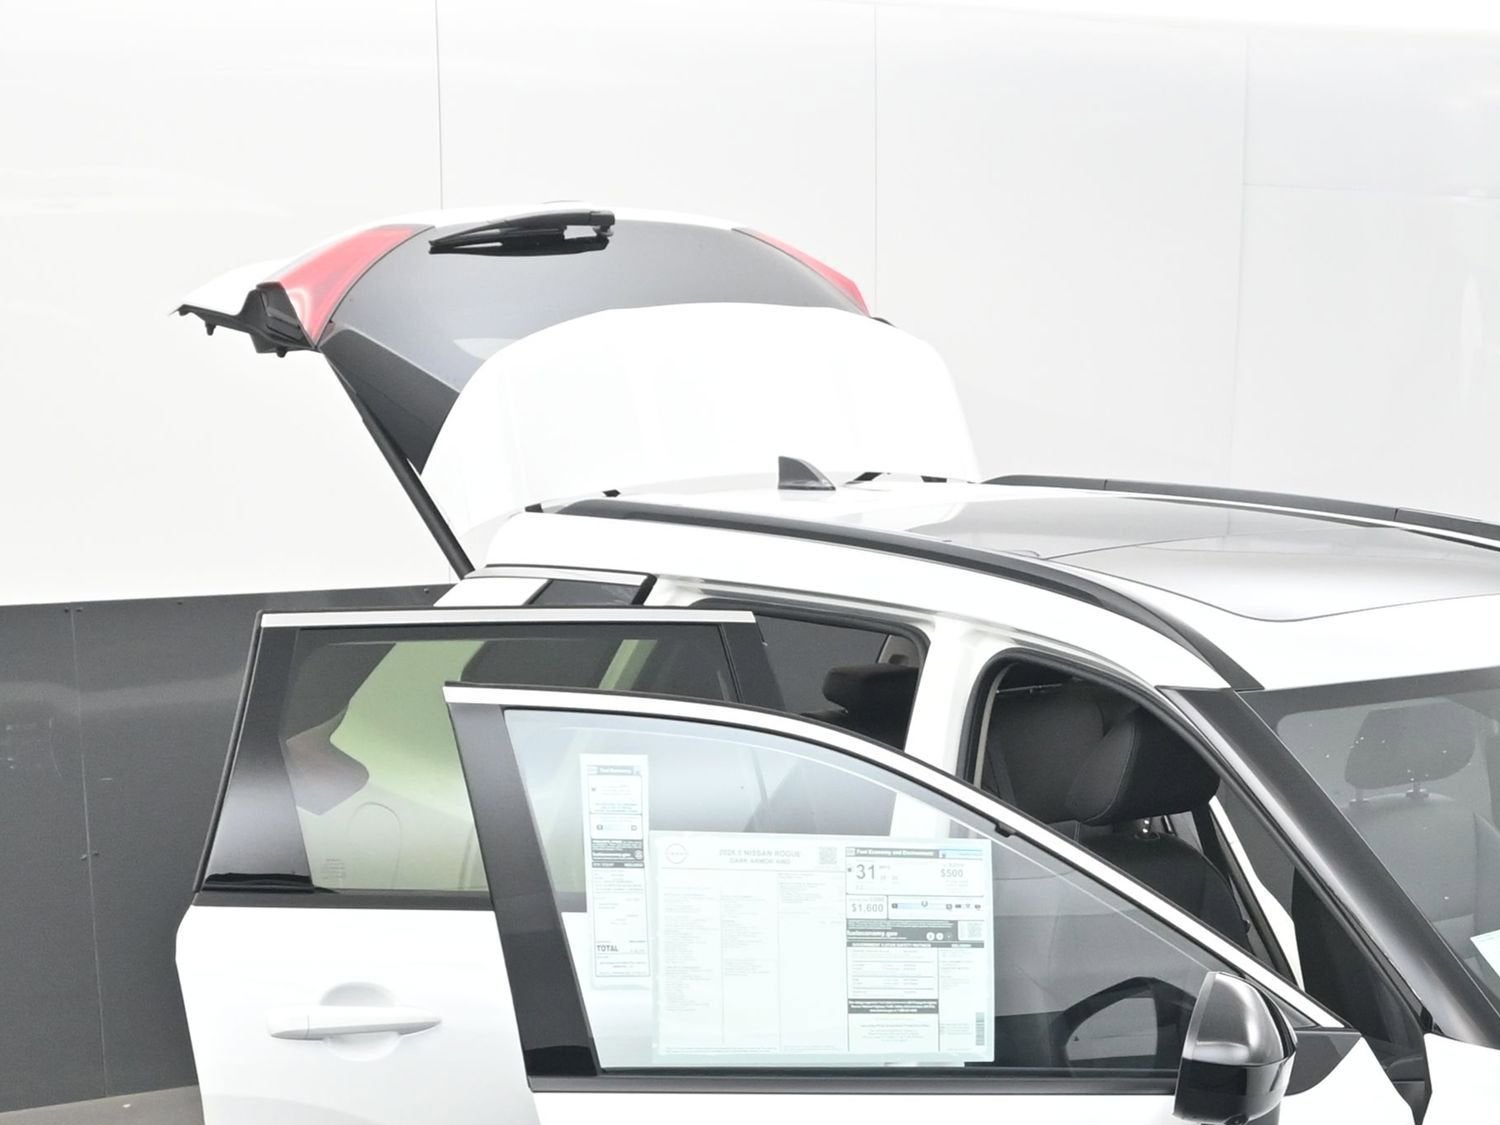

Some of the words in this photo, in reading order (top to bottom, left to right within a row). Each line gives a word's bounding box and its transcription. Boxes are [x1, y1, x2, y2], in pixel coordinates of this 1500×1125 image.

[855, 864, 875, 880] 31
[940, 868, 964, 878] $500
[597, 944, 618, 952] TOTAL
